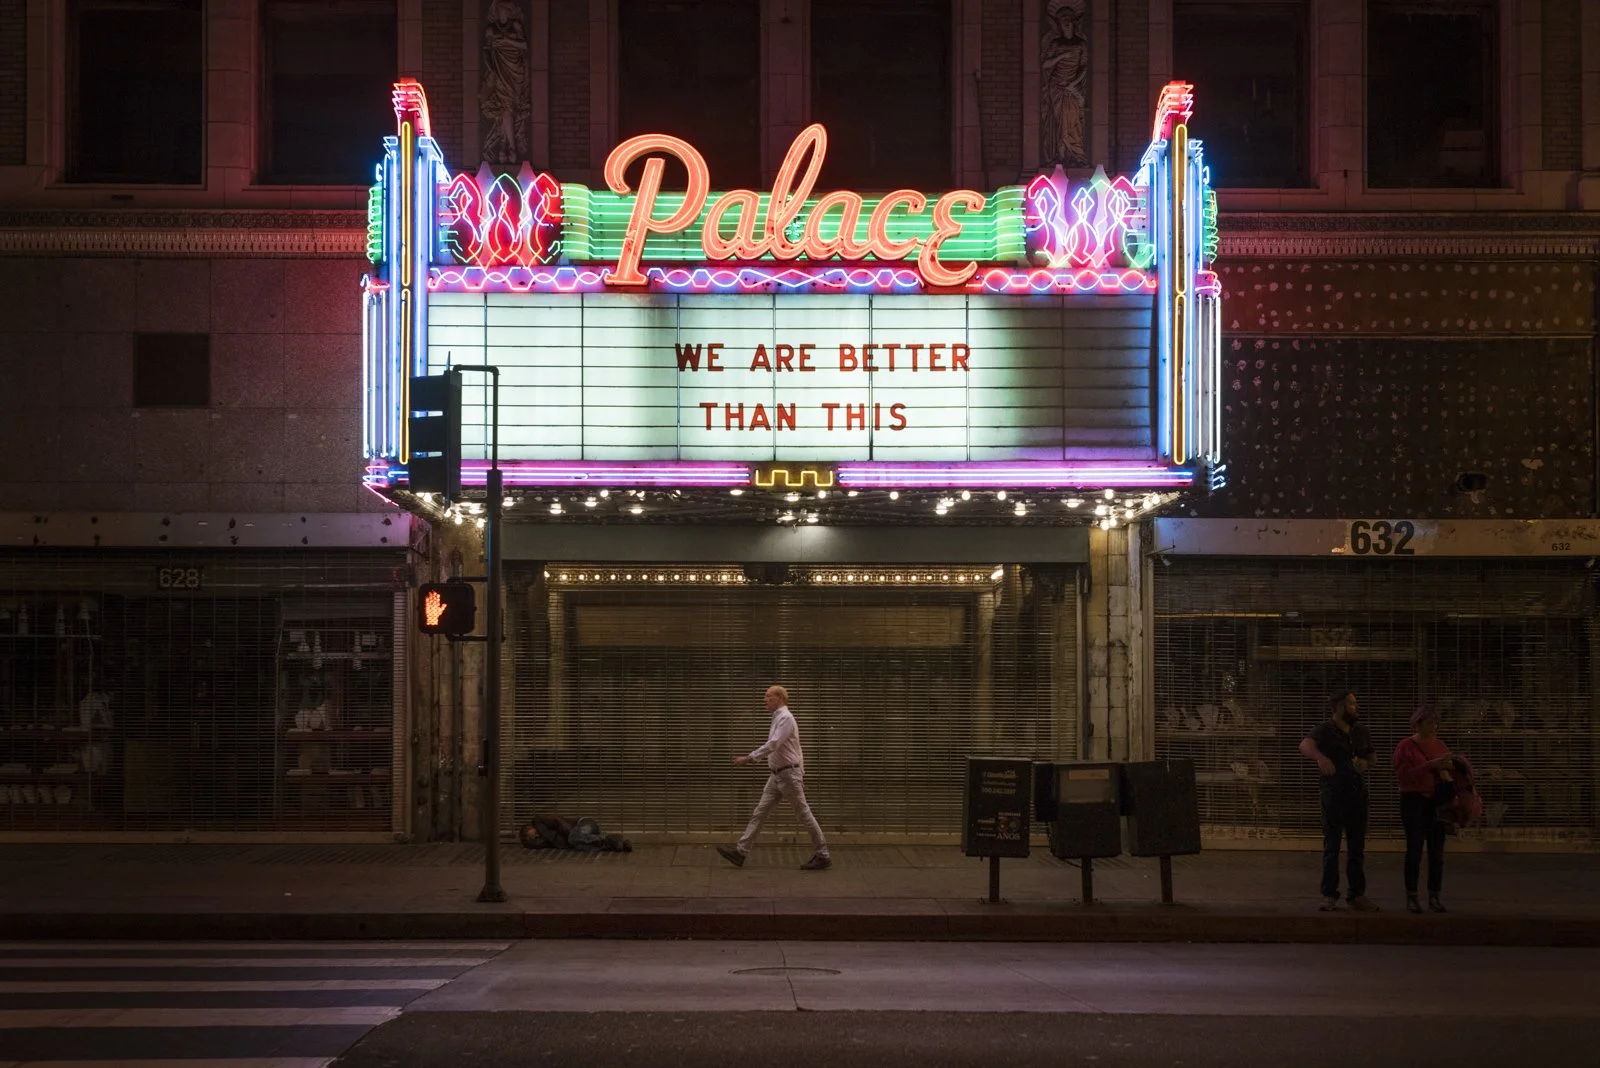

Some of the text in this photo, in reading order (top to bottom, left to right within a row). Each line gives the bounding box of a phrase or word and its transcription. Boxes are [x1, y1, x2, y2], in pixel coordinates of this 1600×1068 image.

[604, 123, 985, 287] Palace
[675, 343, 970, 372] WE ARE BETTER
[699, 402, 907, 431] THAN THIS
[1351, 520, 1415, 555] 632
[1551, 542, 1571, 551] 632
[159, 568, 200, 588] 628
